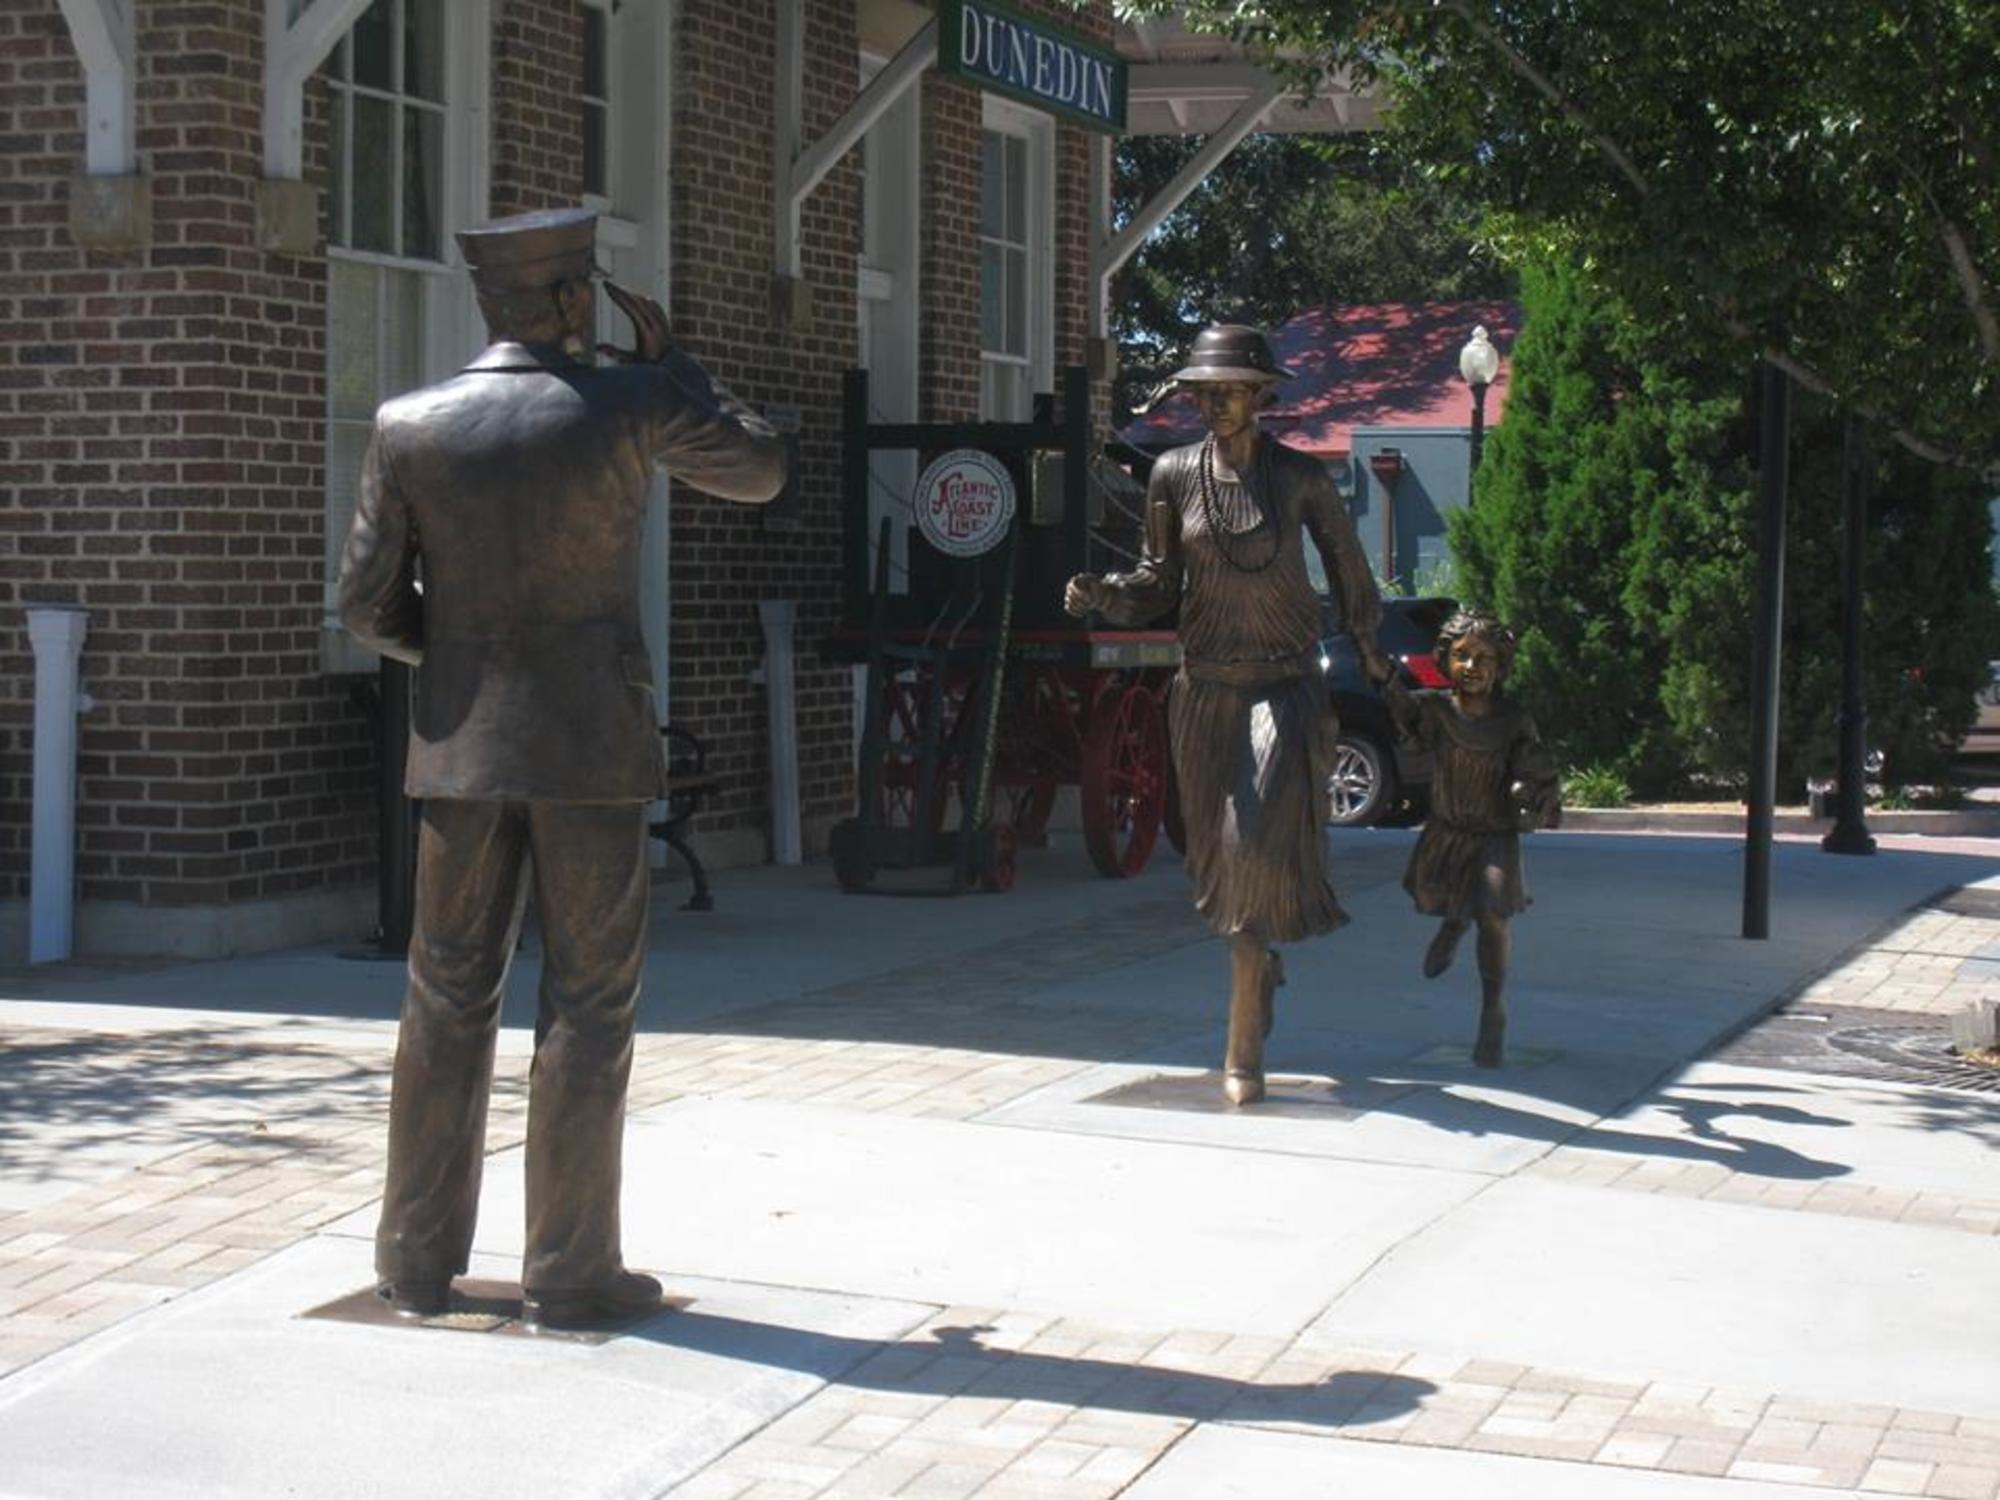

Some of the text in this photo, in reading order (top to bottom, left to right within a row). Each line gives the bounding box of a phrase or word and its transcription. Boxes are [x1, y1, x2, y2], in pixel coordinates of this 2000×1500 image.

[961, 4, 1113, 119] DUNEDIN
[932, 471, 998, 514] ATLANTIC
[950, 500, 994, 517] COAST
[948, 511, 981, 538] LINE
